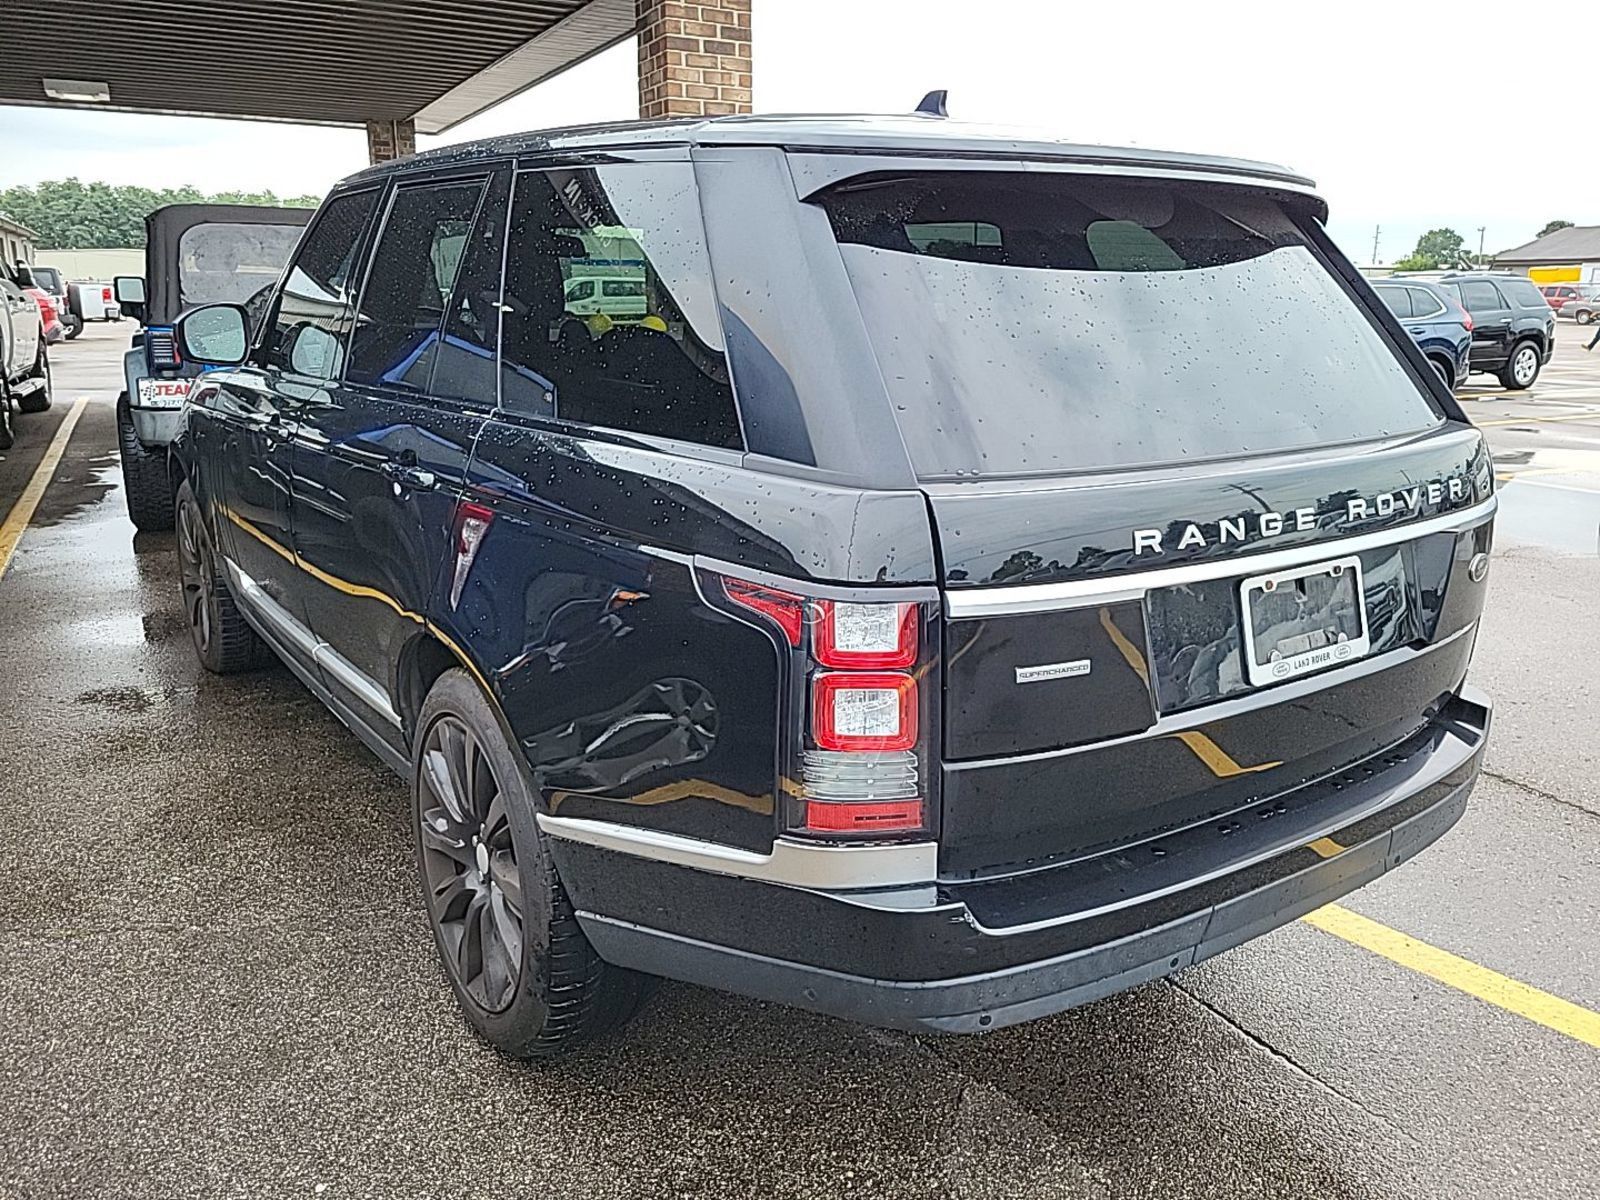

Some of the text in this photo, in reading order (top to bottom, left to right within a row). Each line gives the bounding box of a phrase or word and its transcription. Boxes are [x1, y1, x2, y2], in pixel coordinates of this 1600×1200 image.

[1133, 478, 1464, 556] RANGE ROVER
[1293, 658, 1310, 670] LAND
[1311, 651, 1331, 665] ROVER
[1019, 664, 1089, 679] SUPERCHARGED
